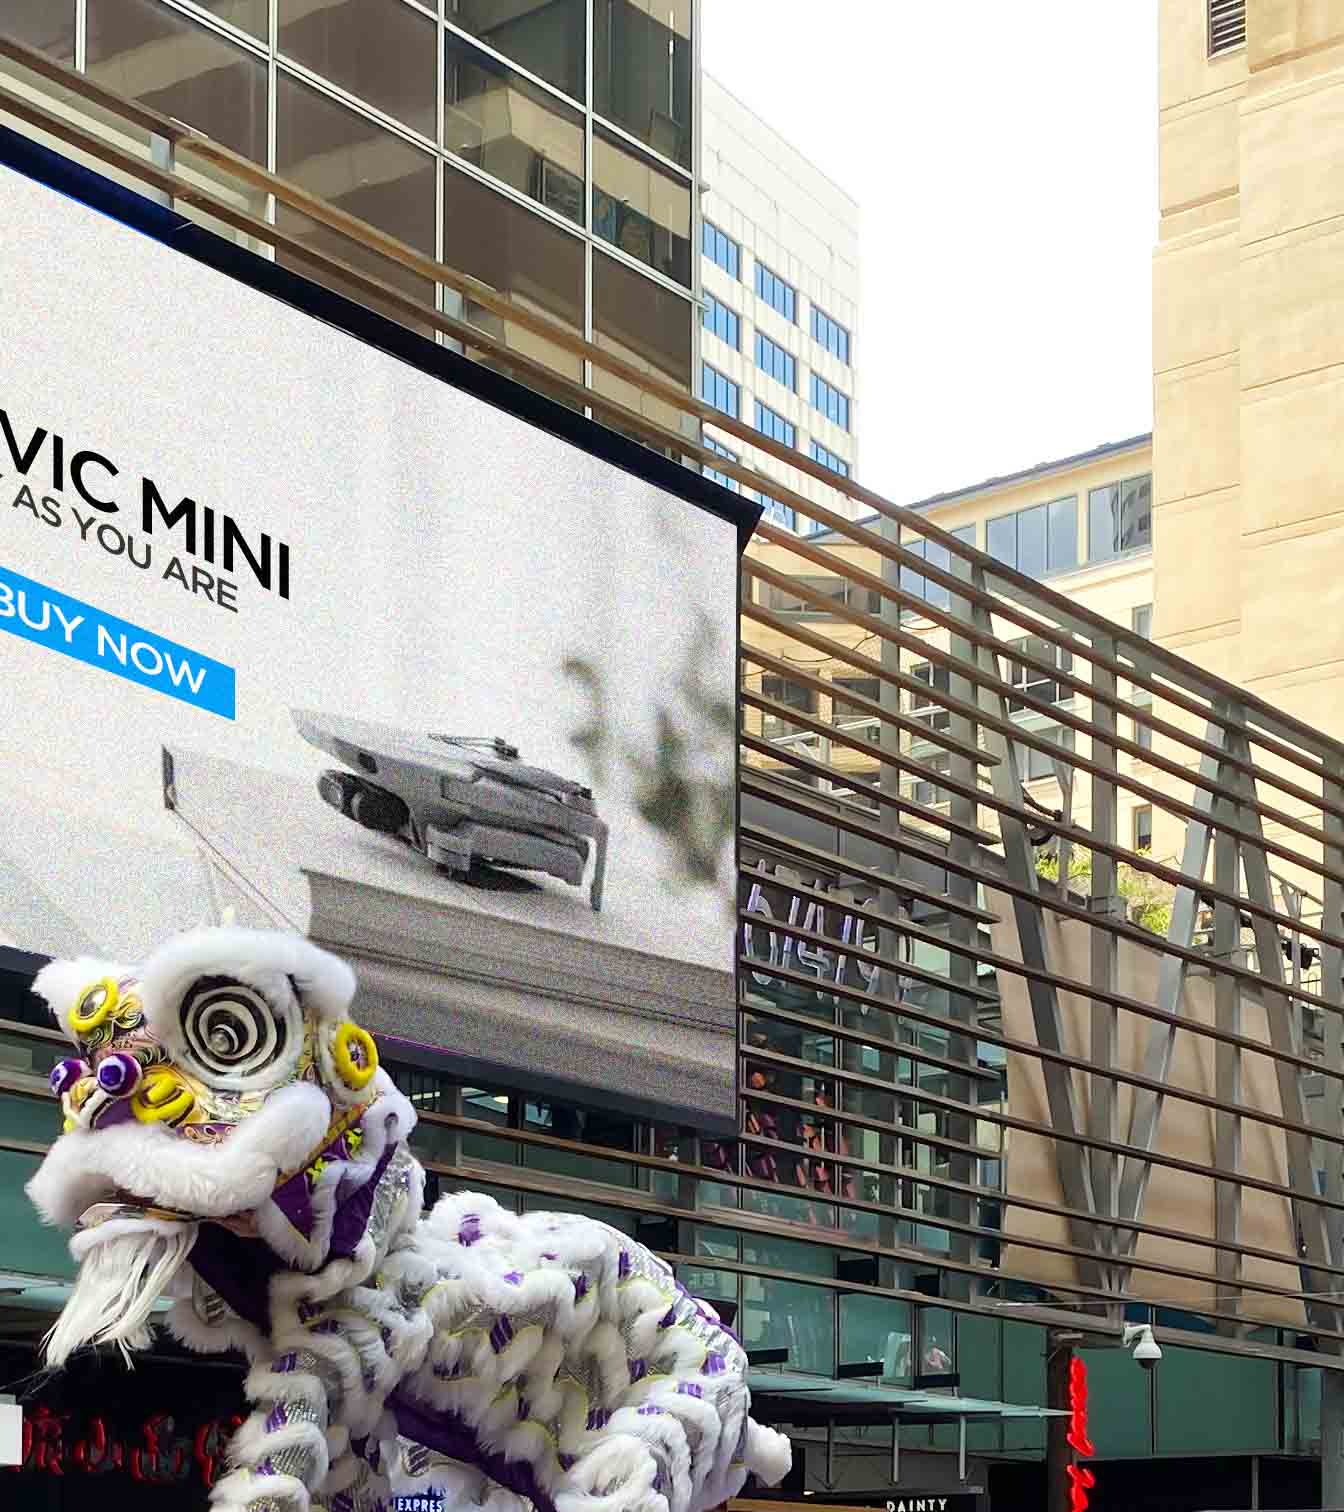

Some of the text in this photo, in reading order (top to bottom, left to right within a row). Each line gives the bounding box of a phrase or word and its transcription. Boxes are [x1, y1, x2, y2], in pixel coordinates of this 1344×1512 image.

[12, 484, 62, 528] AS
[70, 507, 152, 570] YOU
[162, 556, 238, 613] ARE
[142, 477, 290, 600] MINI
[96, 624, 208, 694] NOW
[397, 1498, 442, 1512] EXPRES
[886, 1499, 947, 1512] DAINTY
